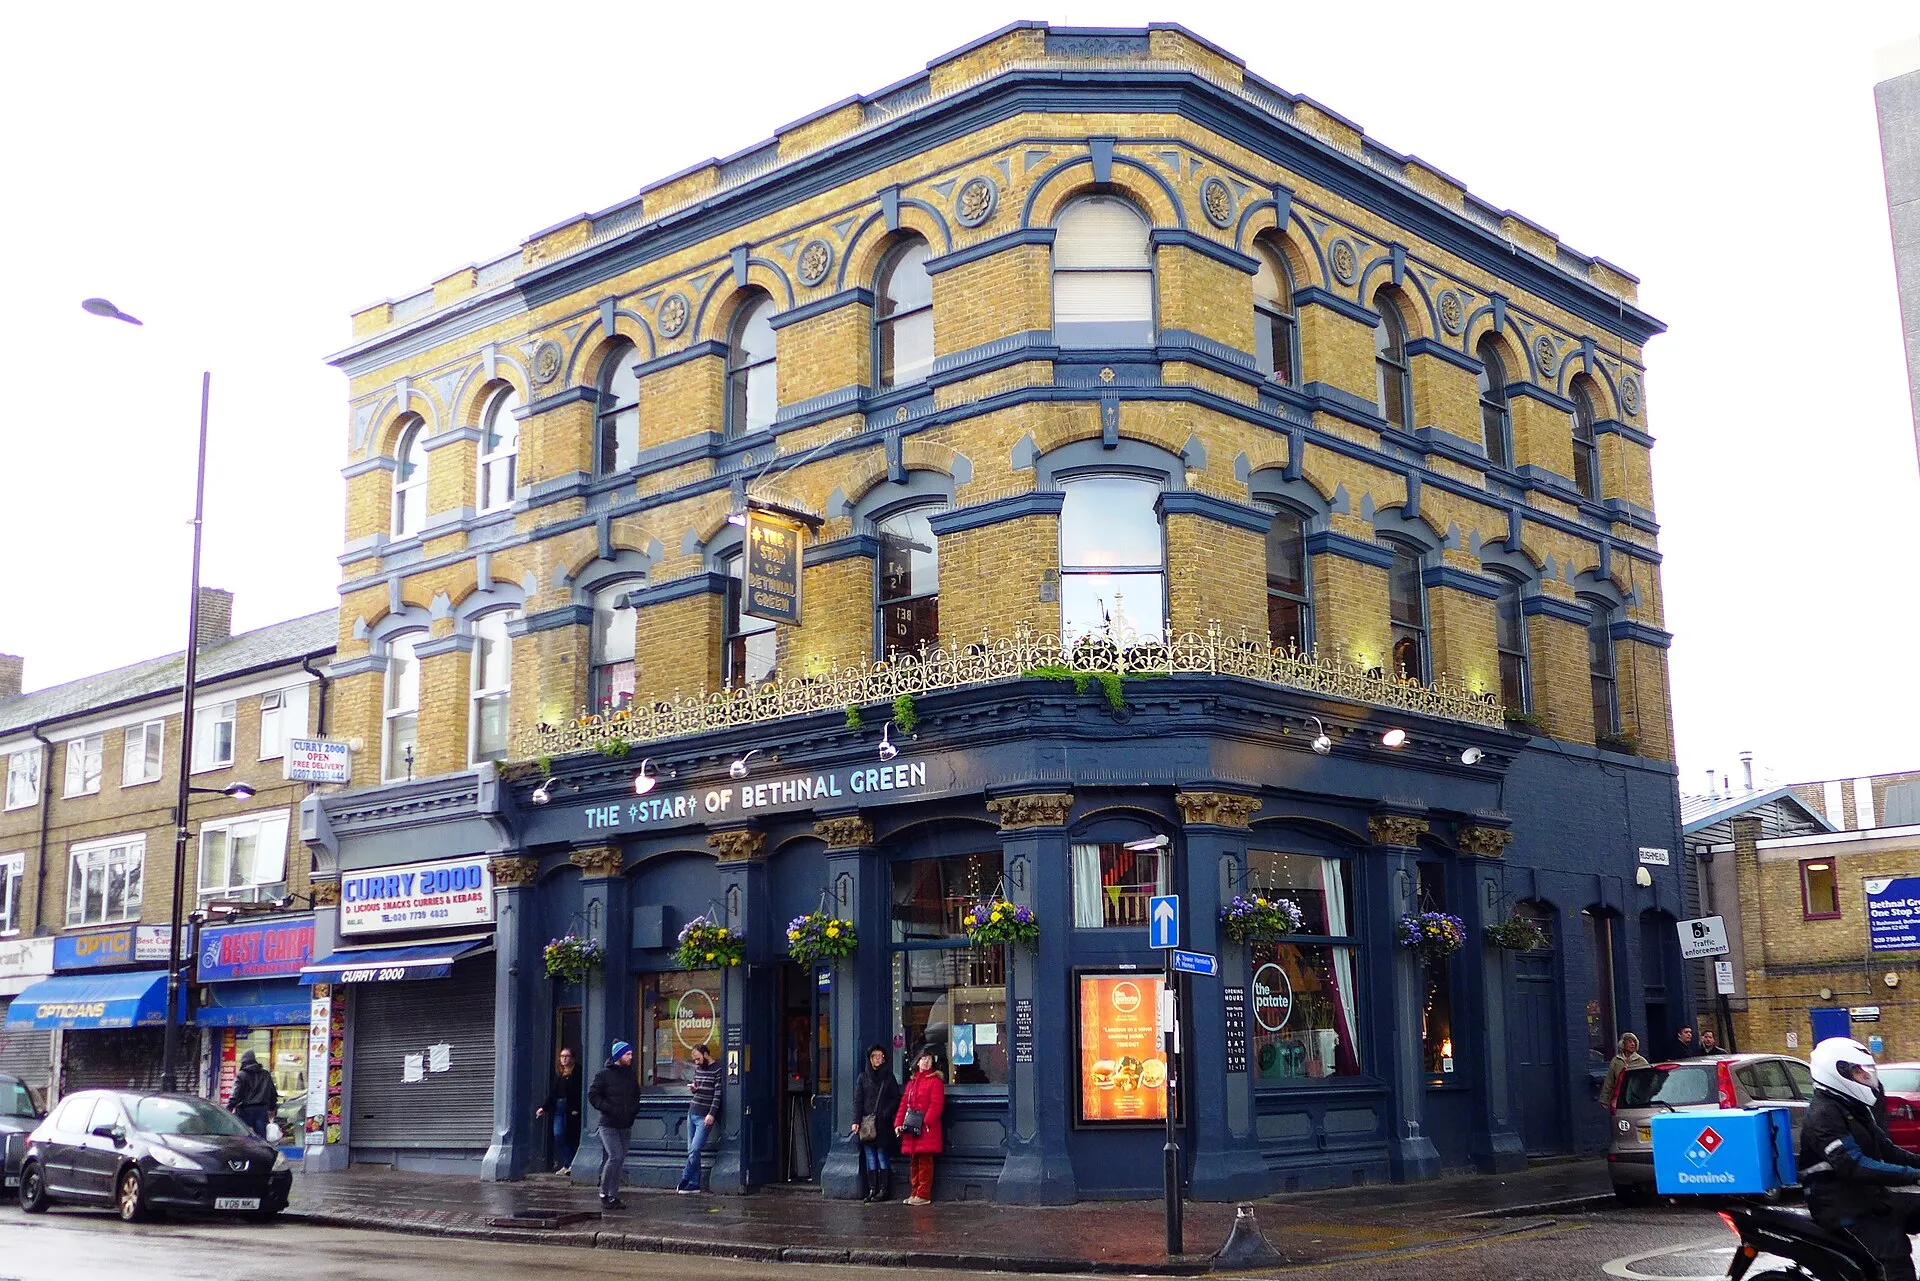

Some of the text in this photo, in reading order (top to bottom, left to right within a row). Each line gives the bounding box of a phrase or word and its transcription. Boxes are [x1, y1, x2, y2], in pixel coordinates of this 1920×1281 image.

[762, 527, 785, 548] THE
[760, 544, 786, 565] STAR
[765, 563, 781, 577] OF
[749, 573, 796, 598] BETHNAL
[754, 591, 790, 612] GREEN
[293, 741, 346, 754] CURRY 2000
[307, 752, 330, 761] OPEN
[293, 760, 345, 771] FREE DELIVERY
[585, 761, 926, 829] THE STAR OF BETHNAL GREEN
[1639, 850, 1666, 862] RUSHMEAD
[343, 865, 482, 903] CURRY 2000
[345, 902, 381, 914] DLICIOUS
[383, 899, 411, 911] SNACKS
[413, 896, 445, 908] CURRIES
[453, 892, 483, 904] KEBABS
[1870, 898, 1905, 909] Bethnal
[1871, 909, 1890, 917] One
[1891, 908, 1913, 918] Stop
[221, 931, 261, 966] BEST
[1692, 938, 1715, 948] Traffic
[1685, 944, 1727, 957] enforcement
[341, 967, 405, 983] CURRY 2000
[1254, 982, 1270, 996] the
[36, 1002, 106, 1019] OPTICIANS
[1255, 995, 1289, 1012] patate
[679, 1007, 694, 1018] the
[679, 1017, 712, 1034] patate
[1228, 1056, 1246, 1064] SUN
[1677, 1171, 1736, 1184] Domino's
